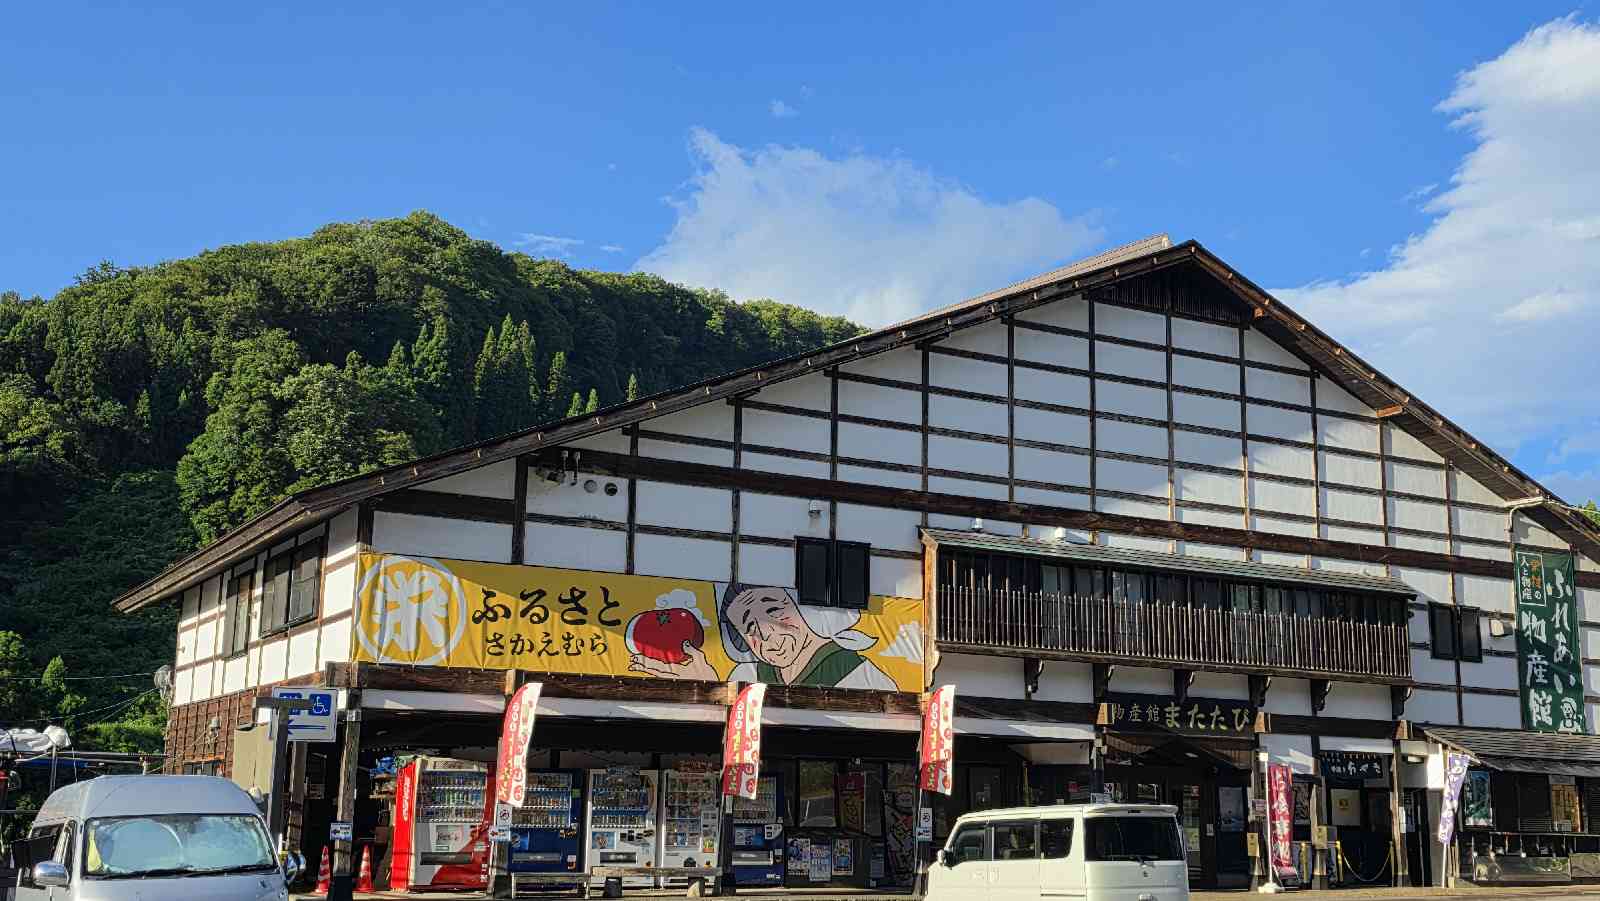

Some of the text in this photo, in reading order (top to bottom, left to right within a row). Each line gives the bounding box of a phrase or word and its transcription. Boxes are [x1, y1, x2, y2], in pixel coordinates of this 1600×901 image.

[371, 570, 449, 653] 栄
[471, 586, 622, 626] ふるさと
[1547, 568, 1576, 695] ふれあい
[485, 631, 609, 658] さかえむら
[1521, 609, 1553, 728] 物産館
[1163, 701, 1250, 732] またたび
